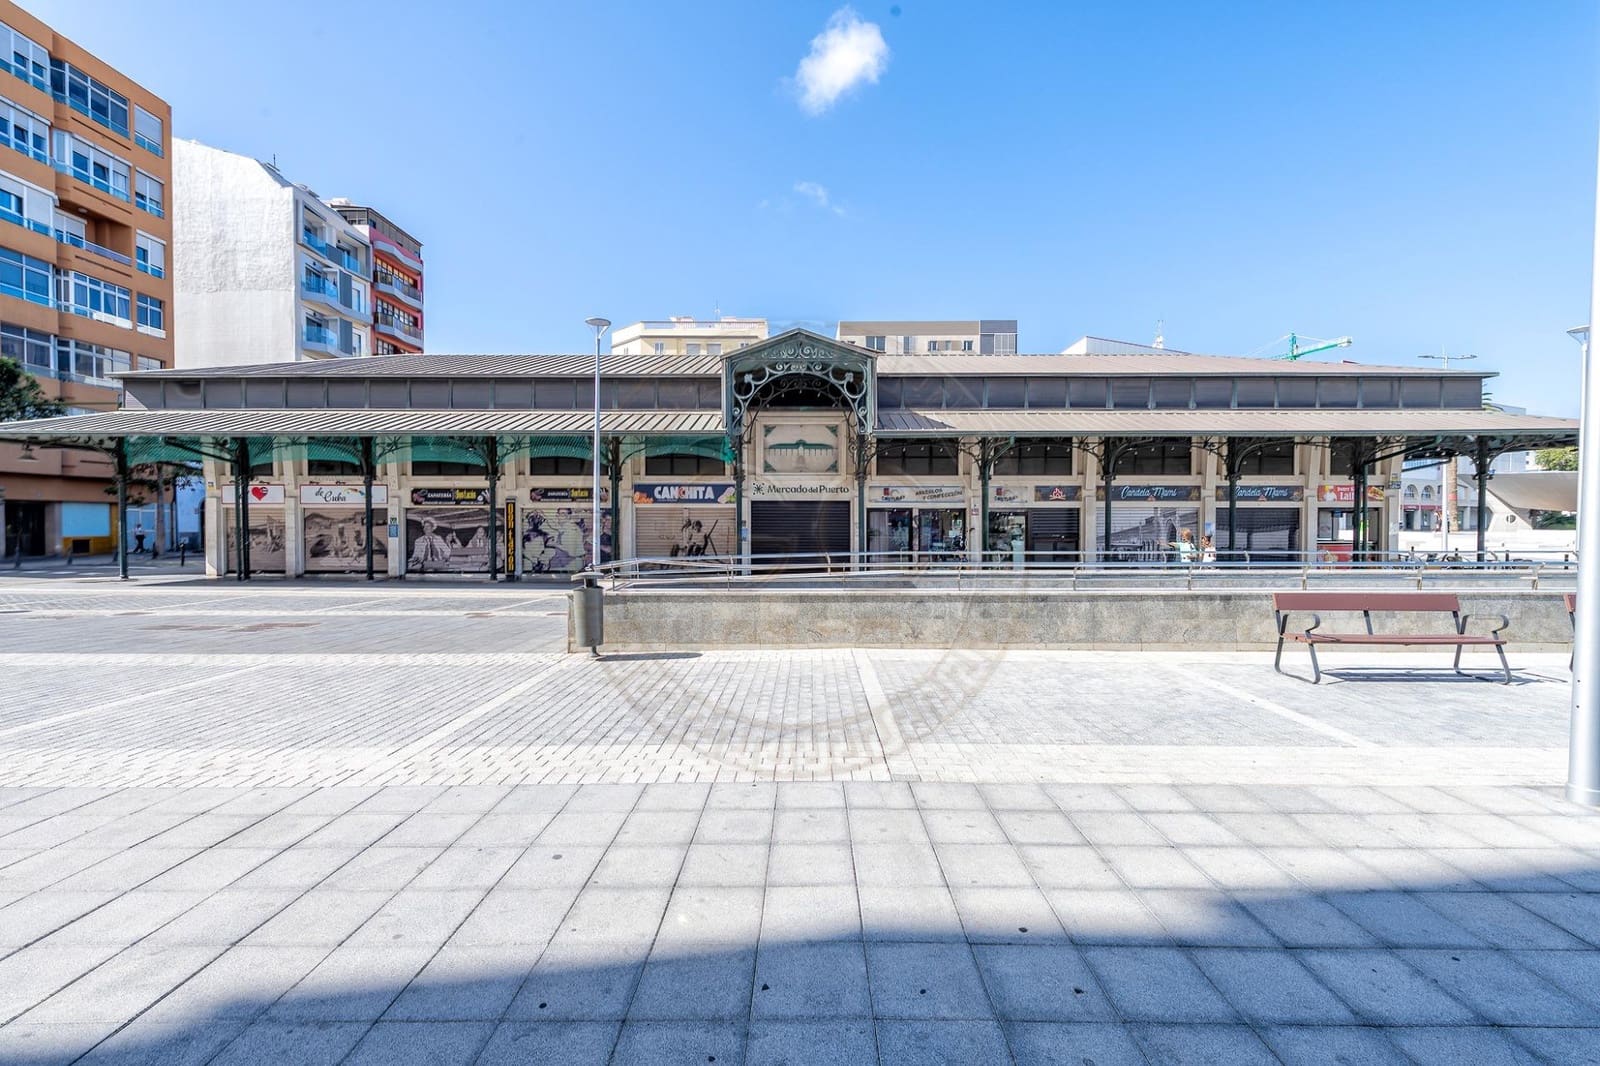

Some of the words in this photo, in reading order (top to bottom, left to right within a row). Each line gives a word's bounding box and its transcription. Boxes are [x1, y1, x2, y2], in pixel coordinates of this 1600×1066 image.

[315, 487, 324, 496] de
[653, 486, 715, 499] CANCHITA
[767, 484, 807, 494] Mercado
[808, 486, 818, 494] del
[819, 484, 850, 494] Puerto
[1121, 485, 1150, 499] Candela
[324, 490, 346, 502] Cuba
